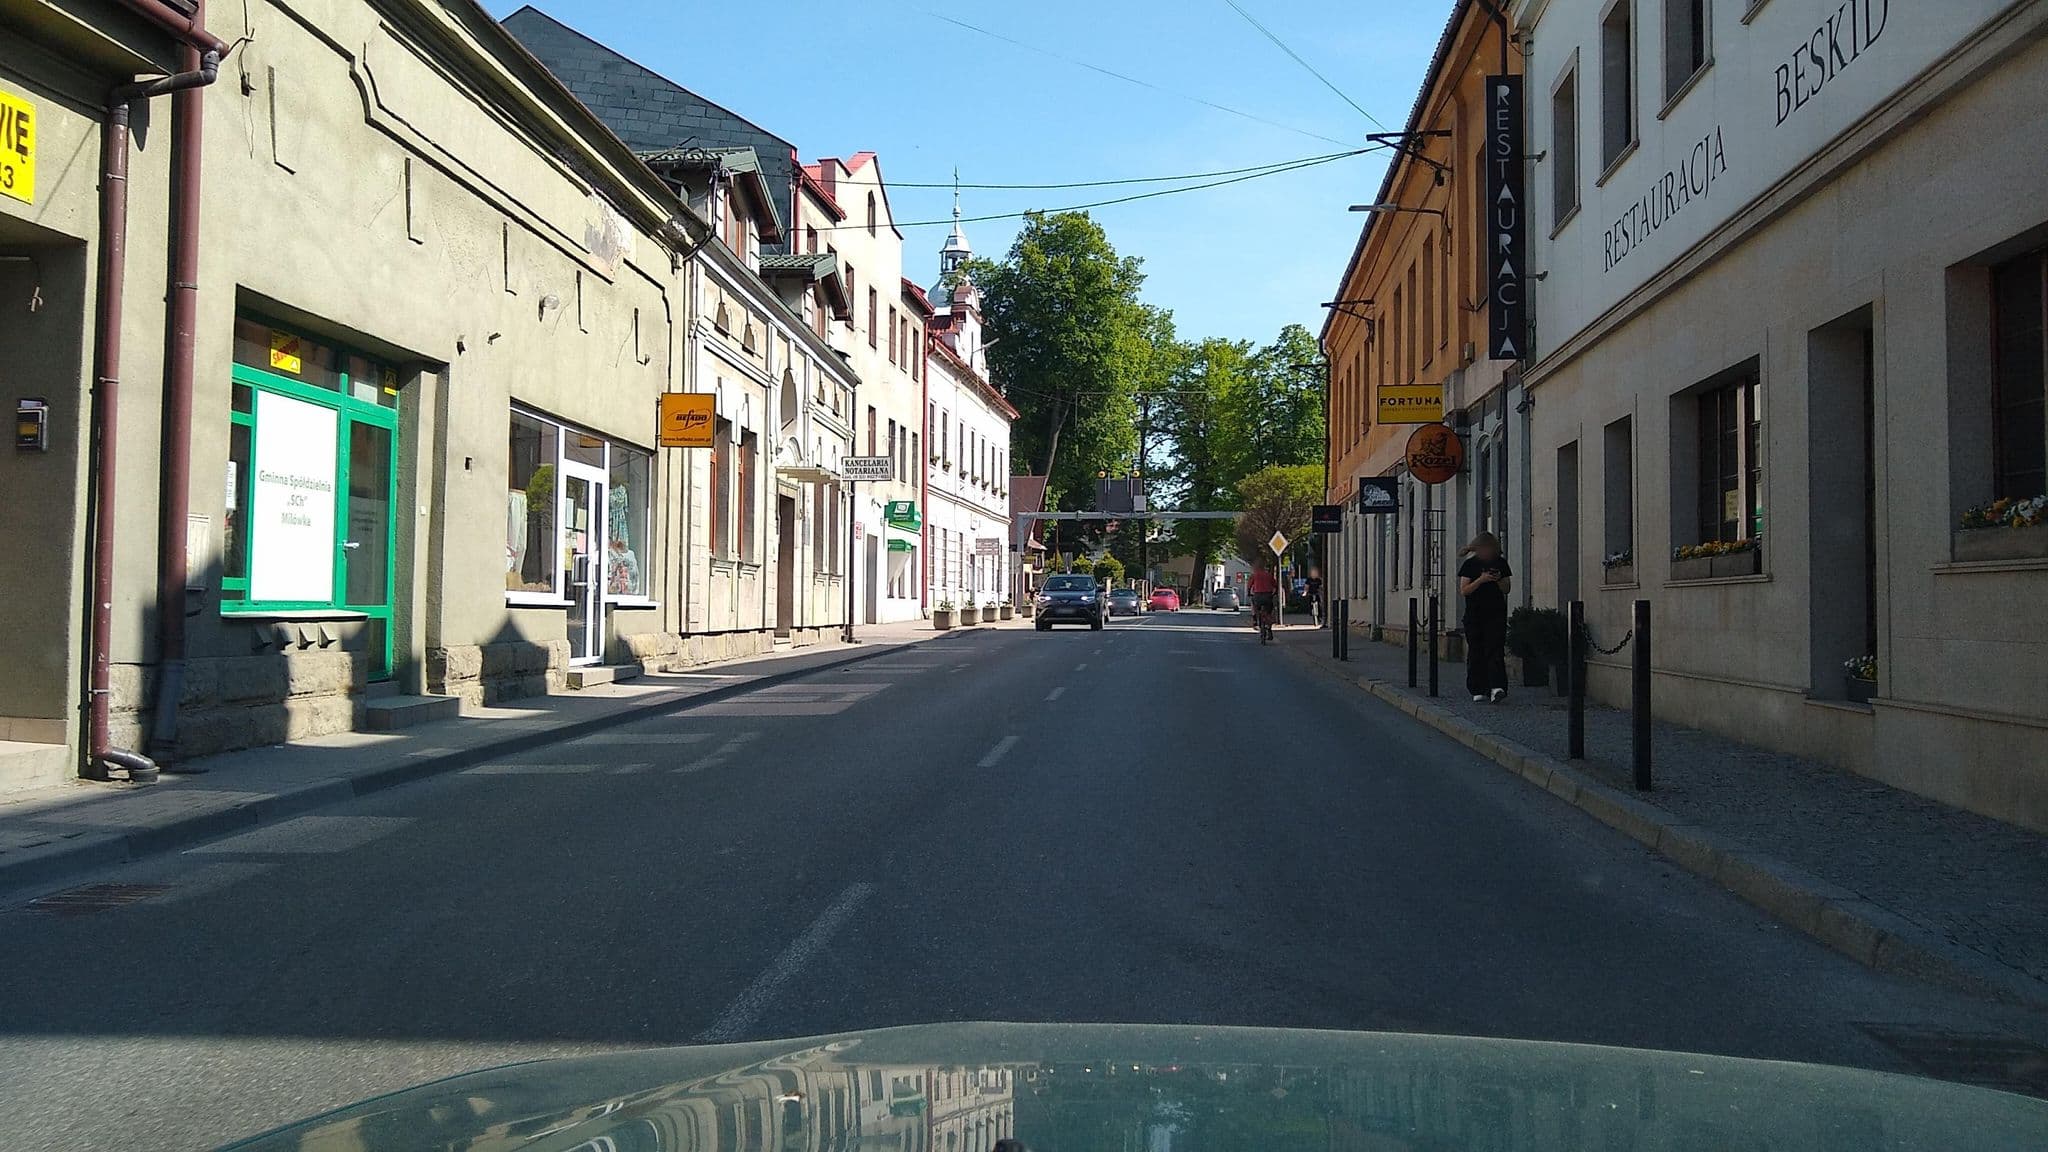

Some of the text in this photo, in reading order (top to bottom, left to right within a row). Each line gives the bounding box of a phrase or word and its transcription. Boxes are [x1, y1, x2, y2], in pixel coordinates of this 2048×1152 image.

[1604, 0, 1889, 273] RESTAURACJA BESKID
[1495, 84, 1518, 357] RESTAURACJA
[1380, 397, 1441, 406] FORTUNA
[845, 459, 888, 467] KANCELARIA
[259, 470, 331, 492] Gminna Spółdzielnia
